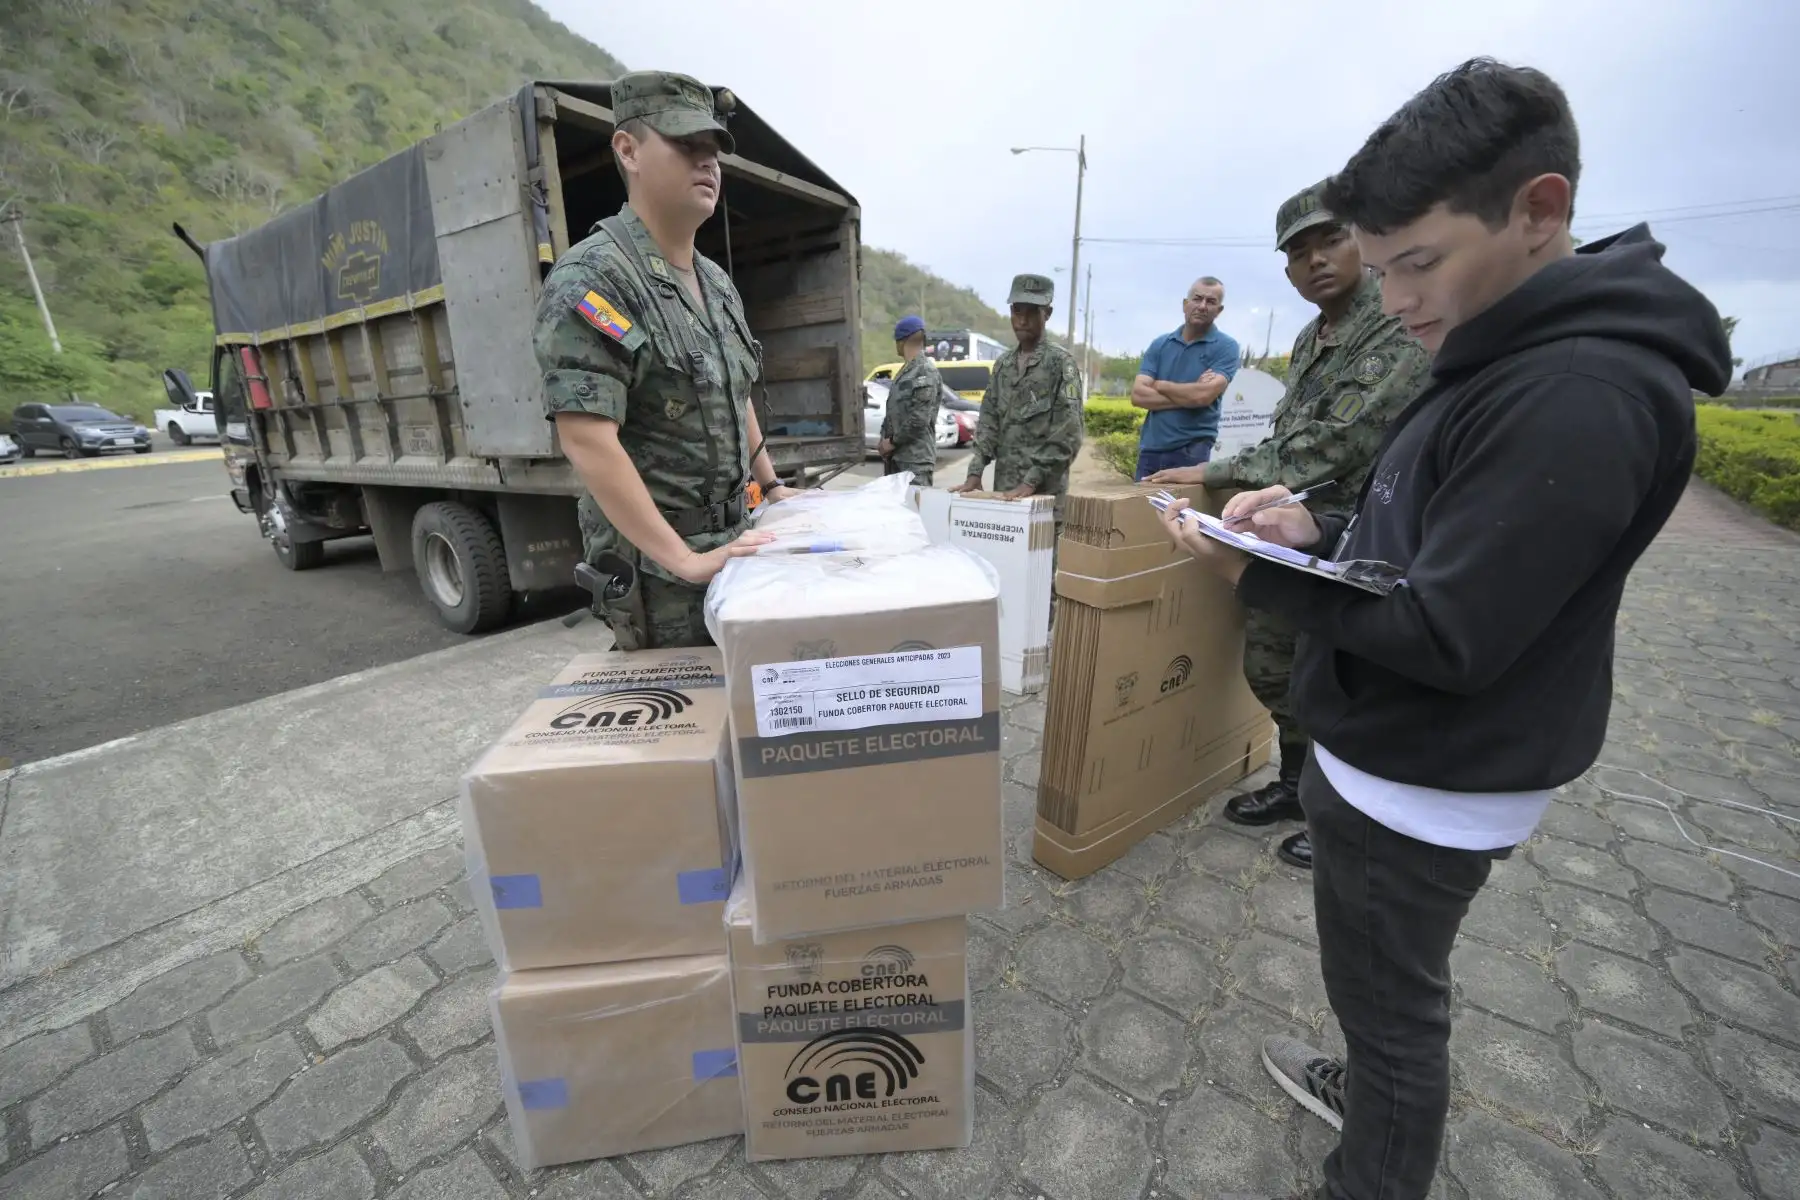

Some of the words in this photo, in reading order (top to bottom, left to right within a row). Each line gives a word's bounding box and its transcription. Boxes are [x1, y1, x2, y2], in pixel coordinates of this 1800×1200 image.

[825, 657, 861, 669] ELECCIONES
[861, 655, 895, 666] GENERALES
[896, 653, 935, 663] ANTICIPADAS
[937, 652, 951, 660] 2023
[570, 676, 635, 686] PAQUETE
[636, 673, 717, 682] ELECTORAL
[582, 669, 627, 679] FUNDA
[630, 665, 712, 675] COBERTORA
[554, 684, 630, 695] PAQUETE
[632, 678, 720, 689] ELECTORAL
[836, 689, 866, 702] SELLO
[869, 688, 882, 699] DE
[885, 684, 940, 698] SEGURIDAD
[770, 705, 803, 717] 1302150
[818, 708, 845, 718] FUNDA
[847, 703, 887, 716] COBERTOR
[889, 701, 923, 711] PAQUETE
[925, 697, 968, 708] ELECTORAL
[524, 729, 576, 739] CONSEJO
[577, 725, 635, 735] NACIONAL
[637, 722, 699, 732] ELECTORAL
[761, 738, 859, 765] PAQUETE
[866, 725, 985, 754] ELECTORAL
[922, 855, 991, 873] ELECTORAL
[824, 883, 881, 899] FUERZAS
[883, 875, 944, 891] ARMADAS
[767, 981, 824, 998] FUNDA
[827, 974, 929, 994] COBERTORA
[763, 1001, 838, 1019] PAQUETE
[844, 994, 939, 1013] ELECTORAL
[757, 1016, 841, 1035] PAQUETE
[845, 1010, 948, 1028] ELECTORAL
[773, 1105, 822, 1117] CONSEJO
[824, 1101, 878, 1112] NACIONAL
[881, 1095, 940, 1108] ELECTORAL
[815, 1118, 836, 1128] DEL
[837, 1114, 889, 1125] MATERIAL
[891, 1109, 949, 1122] ELECTORAL
[806, 1126, 855, 1138] FUERZAS
[857, 1122, 909, 1134] ARMADAS
